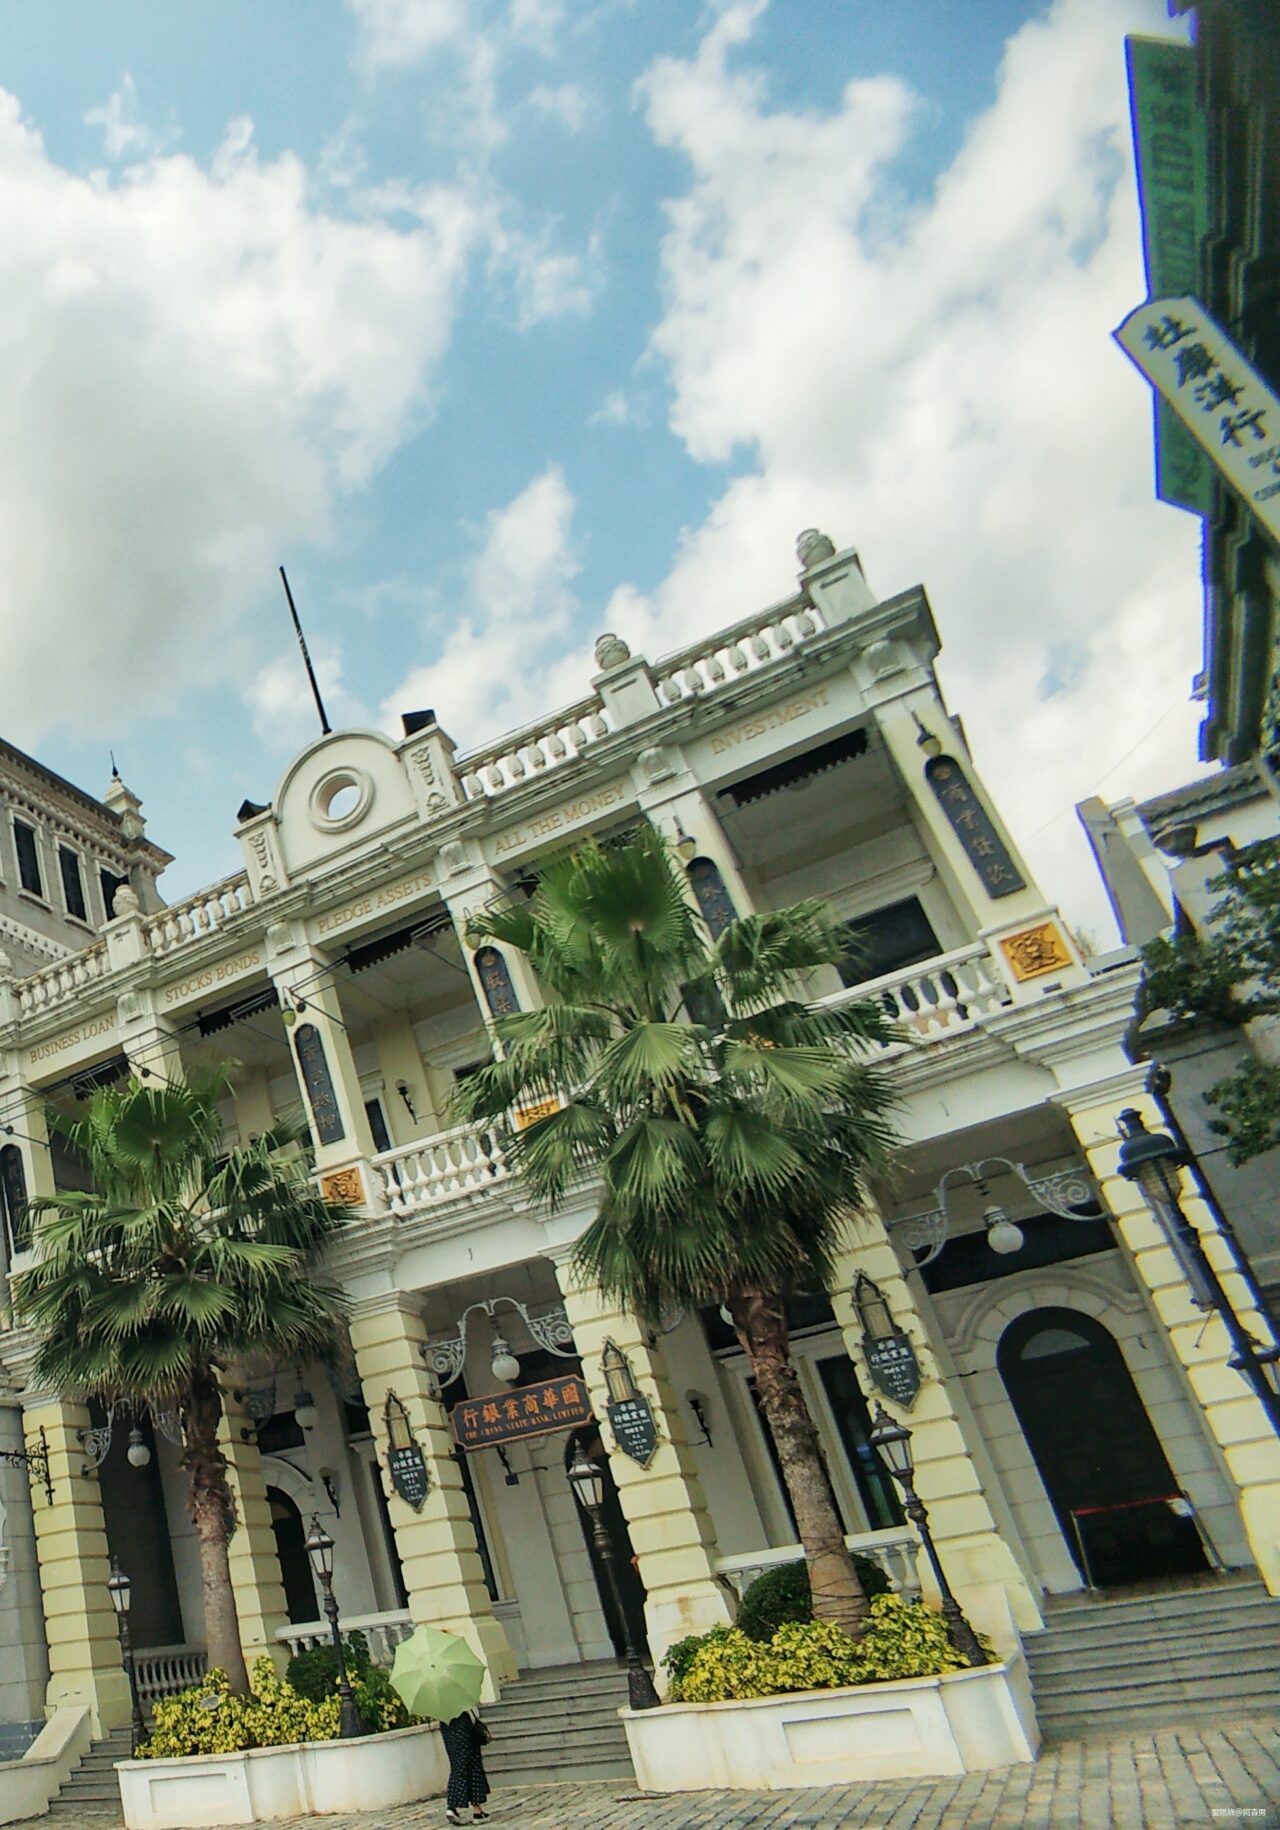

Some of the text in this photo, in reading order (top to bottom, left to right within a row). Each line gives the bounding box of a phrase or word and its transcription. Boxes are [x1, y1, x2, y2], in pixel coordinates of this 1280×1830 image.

[707, 685, 830, 755] INVESTMENT
[495, 783, 624, 855] ALL THE MONEY
[316, 872, 431, 934] PLEDGE ASSETS
[165, 950, 260, 1003] STOCKS BONDS
[30, 1015, 114, 1063] BUSINESS LOAN
